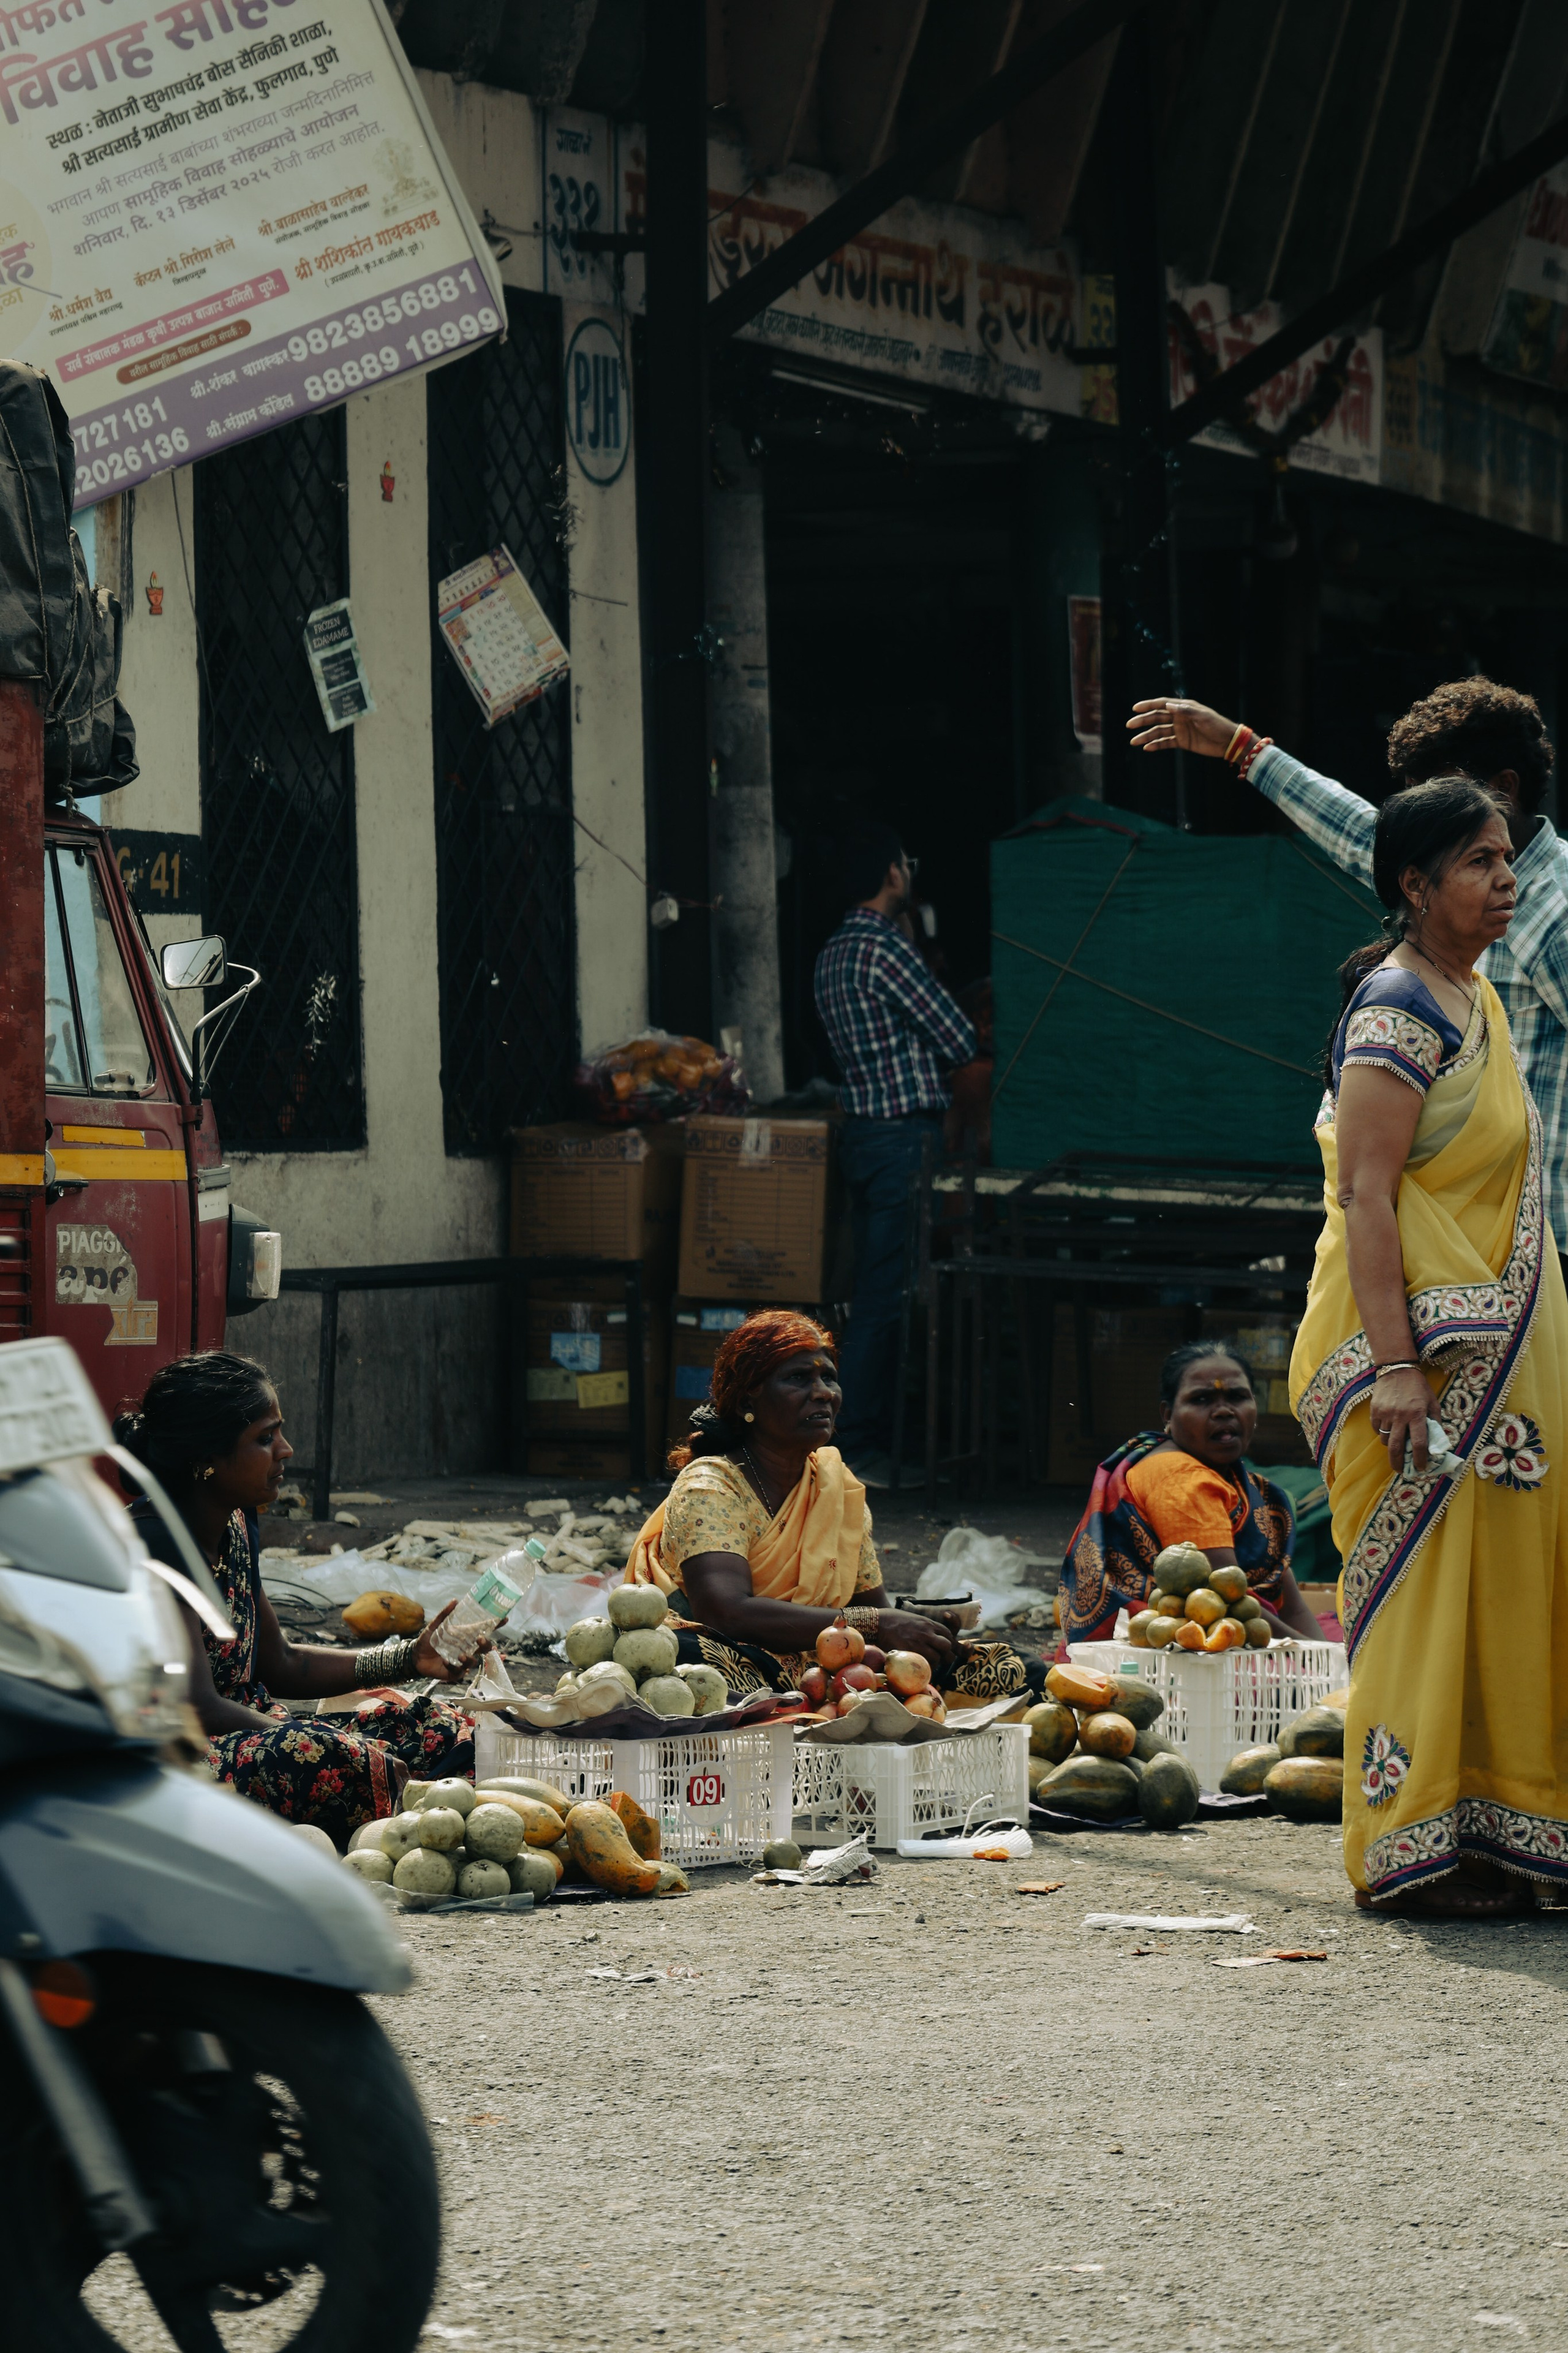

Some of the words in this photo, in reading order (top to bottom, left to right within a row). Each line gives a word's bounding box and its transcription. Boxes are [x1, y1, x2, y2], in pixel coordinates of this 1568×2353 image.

[0, 20, 153, 124] विवाह
[45, 123, 83, 149] स्थळ
[92, 96, 140, 129] नेताजी
[140, 72, 205, 113] सुभाषचंद्र
[205, 62, 236, 81] बोस
[236, 35, 287, 69] सैनिकी
[289, 20, 332, 48] शाळा,
[62, 153, 81, 175] श्री
[81, 126, 141, 166] सत्यसाई
[141, 110, 192, 142] ग्रामीण
[194, 98, 222, 121] सेवा
[222, 86, 254, 107] केंद्र,
[253, 61, 313, 100] फुलगाव,
[312, 45, 339, 75] पुणे
[47, 188, 92, 214] भगवान
[96, 176, 113, 195] श्री
[114, 153, 168, 187] सत्यसाई
[168, 135, 219, 165] बाबांच्या
[280, 70, 375, 118] जन्मदिनानिमित्त
[74, 226, 129, 255] शनिवार,
[130, 215, 153, 233] दि.
[156, 207, 175, 223] १३
[178, 184, 225, 213] डिसेंबर
[230, 168, 271, 190] २०२५
[271, 151, 303, 174] रोजी
[306, 140, 336, 161] करत
[339, 121, 385, 146] आहोत.
[82, 202, 121, 226] आपण
[123, 176, 182, 210] सामूहिक
[184, 159, 226, 186] विवाह
[228, 127, 296, 166] सोहळ्याचे
[301, 104, 360, 137] आयोजन
[295, 258, 313, 281] श्री
[314, 235, 374, 273] शशिकांत
[374, 210, 440, 246] गायकवाड
[65, 353, 82, 372] सर्व
[83, 341, 121, 364] संचालक
[122, 331, 145, 350] मंडळ
[145, 320, 167, 344] कृषी
[195, 301, 224, 319] बाजार
[224, 285, 254, 308] समिती
[178, 343, 199, 360] विवाह
[288, 268, 477, 361] 9823856881
[304, 346, 401, 402] 88889
[405, 307, 499, 362] 18999
[73, 396, 168, 457] 727181
[573, 350, 621, 450] PJH
[73, 427, 189, 495] 2026136
[312, 627, 350, 649] EDAMAME
[313, 616, 341, 635] FROZEN
[693, 1777, 717, 1804] 09
